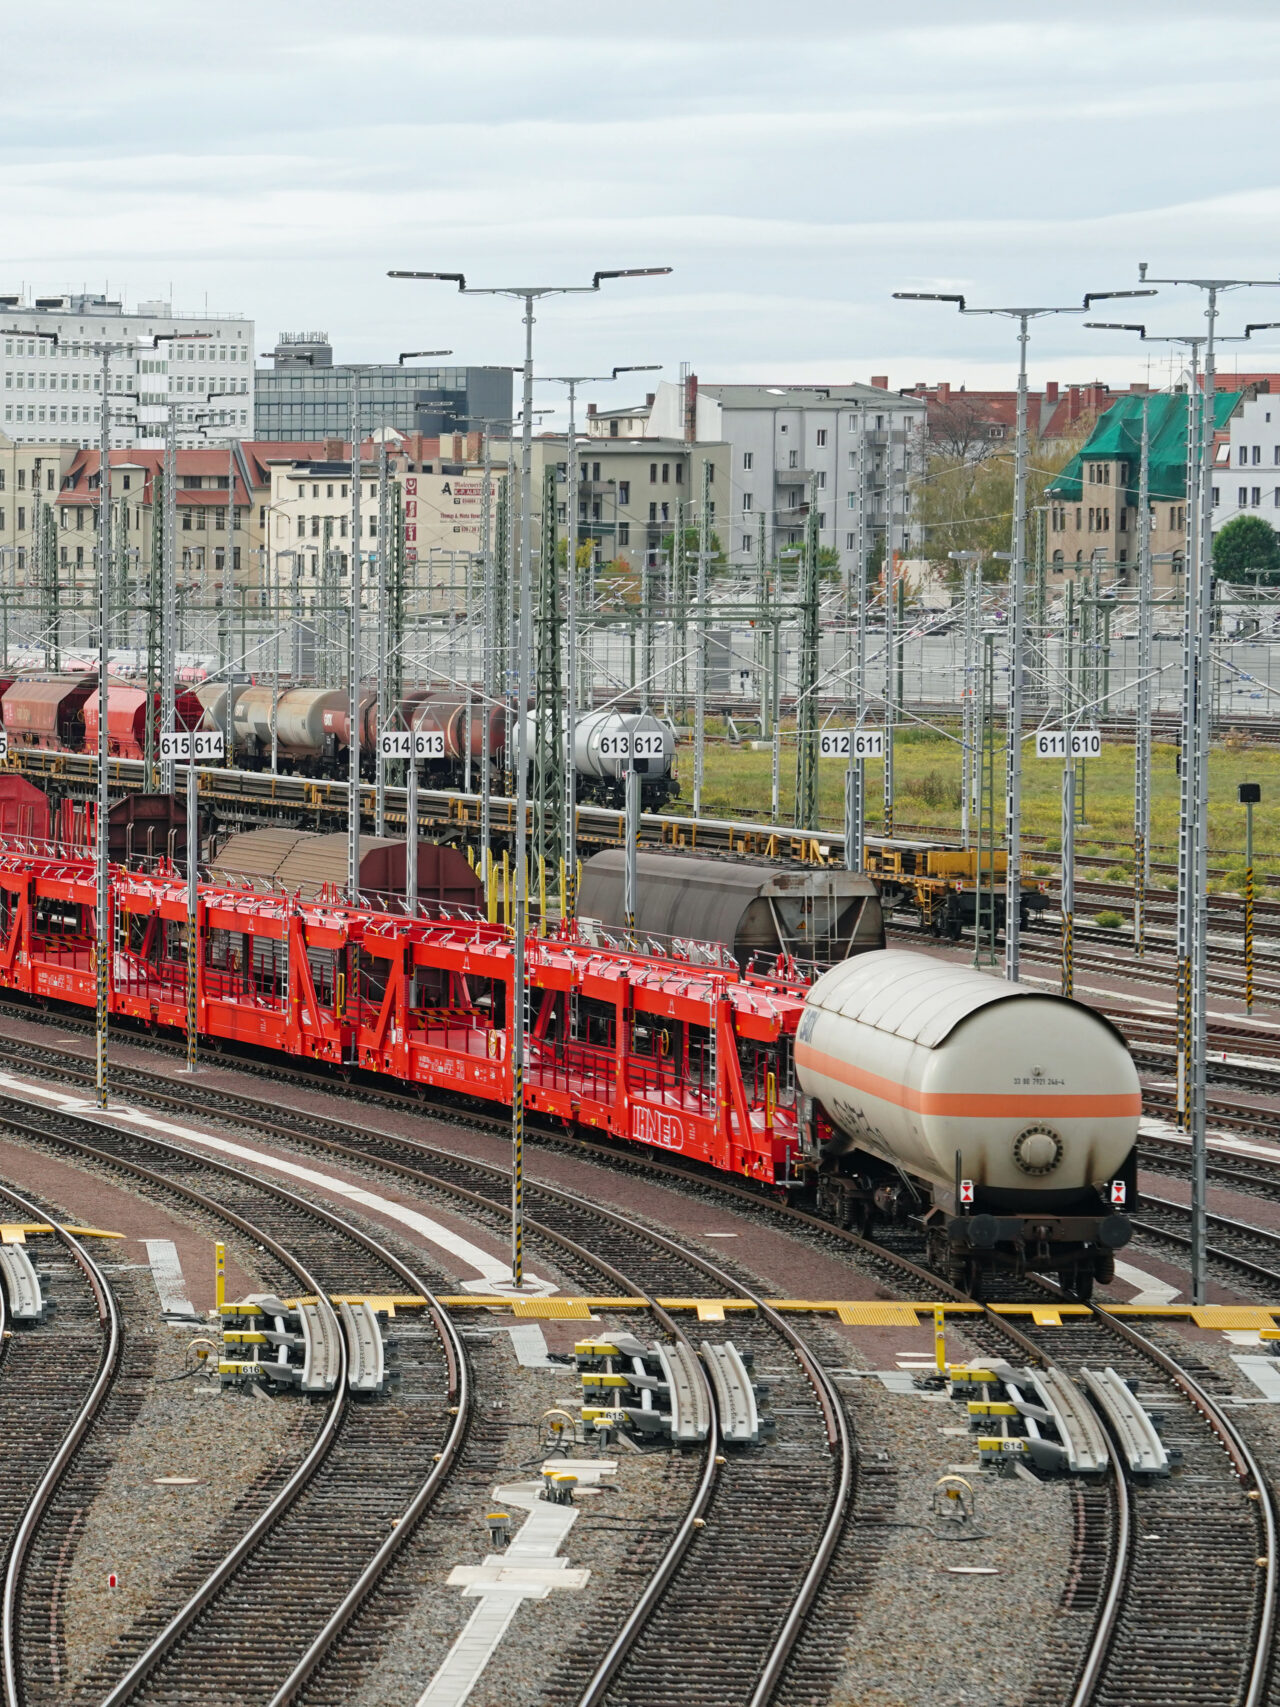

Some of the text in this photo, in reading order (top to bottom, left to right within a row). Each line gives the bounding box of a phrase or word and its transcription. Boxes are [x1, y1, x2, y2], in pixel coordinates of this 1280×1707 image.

[161, 736, 223, 755] 615 614
[382, 736, 444, 754] 614 613
[600, 736, 663, 754] 613 612
[821, 736, 881, 753] 612 611
[1039, 735, 1100, 753] 611 610
[242, 1365, 261, 1374] 616
[605, 1411, 624, 1420] 615
[1003, 1441, 1023, 1450] 614
